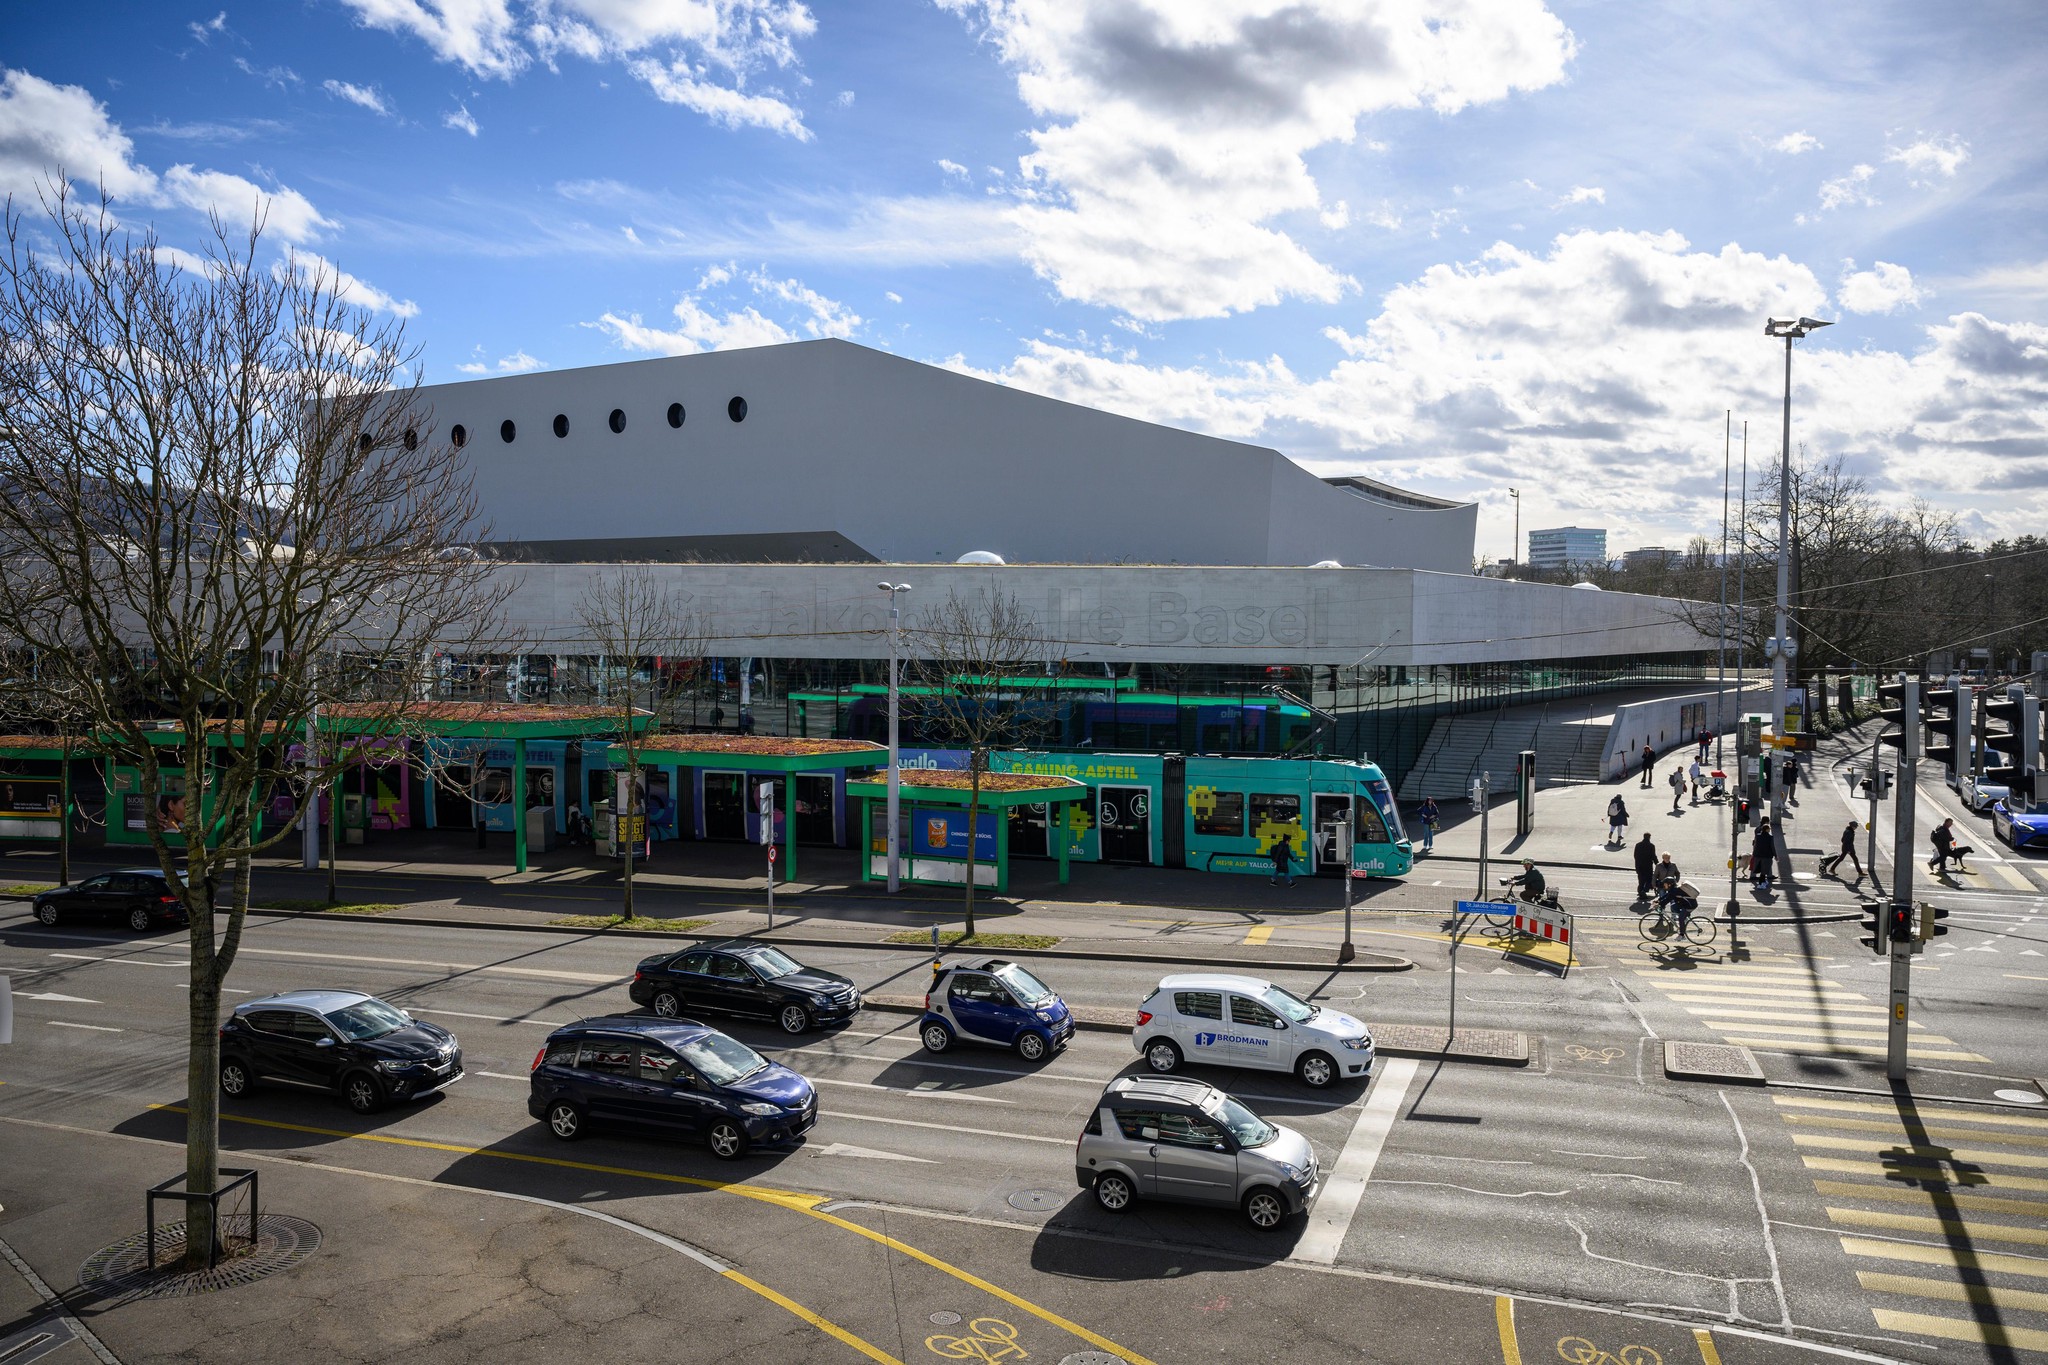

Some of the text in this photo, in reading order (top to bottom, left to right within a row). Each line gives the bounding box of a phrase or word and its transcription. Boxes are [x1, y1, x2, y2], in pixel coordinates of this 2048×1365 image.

[1149, 587, 1328, 645] Basel
[898, 753, 938, 770] yallo
[1012, 763, 1138, 779] GAMING-ABTEIL
[618, 822, 645, 835] SIGT
[1068, 845, 1084, 855] allo
[1356, 858, 1385, 870] yallo
[1217, 1033, 1269, 1046] BRODMANN
